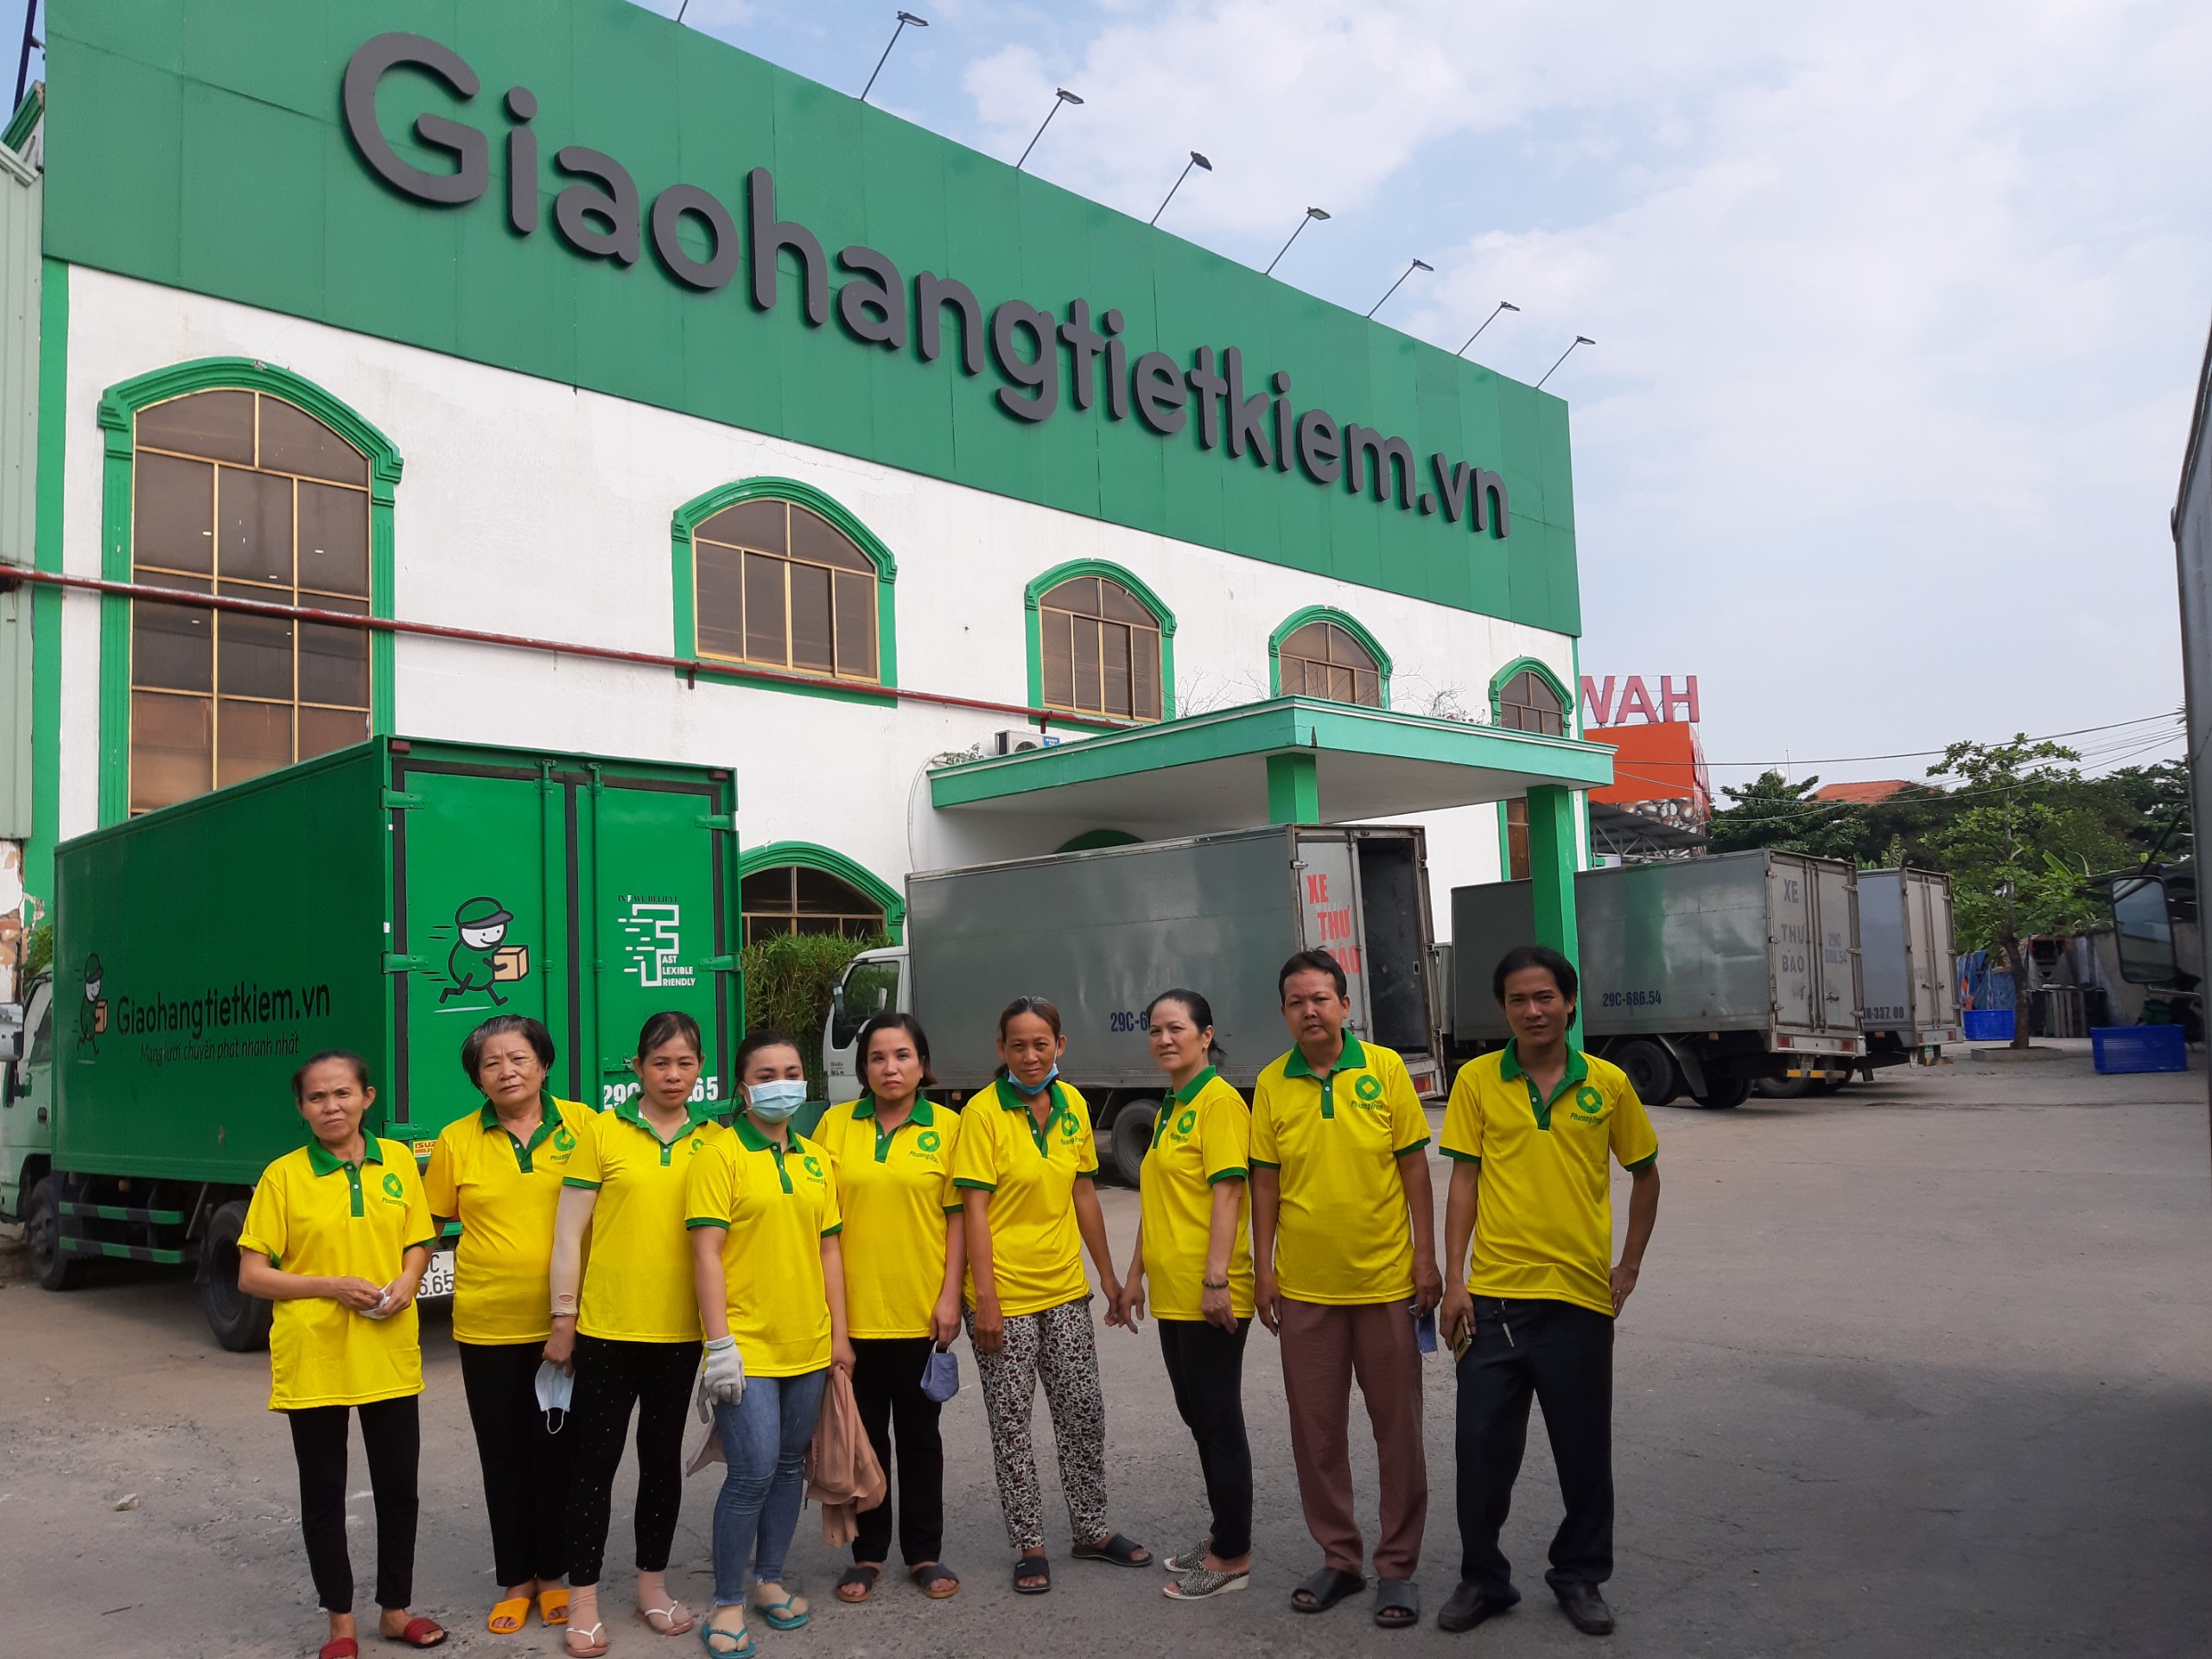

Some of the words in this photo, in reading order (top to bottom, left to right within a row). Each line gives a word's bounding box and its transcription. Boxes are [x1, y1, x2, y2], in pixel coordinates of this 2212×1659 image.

[340, 30, 1511, 540] Giaohangtietkiem.vn
[1306, 874, 1329, 905] XE
[1783, 879, 1799, 904] XE
[662, 966, 694, 976] LEXIBLE
[662, 977, 696, 987] RIENDLY
[1602, 990, 1662, 1007] 29C-686.54
[116, 980, 331, 1040] Giaohangtietkiem.vn
[1110, 1011, 1148, 1033] 29C-6
[415, 1141, 437, 1149] ISUZ
